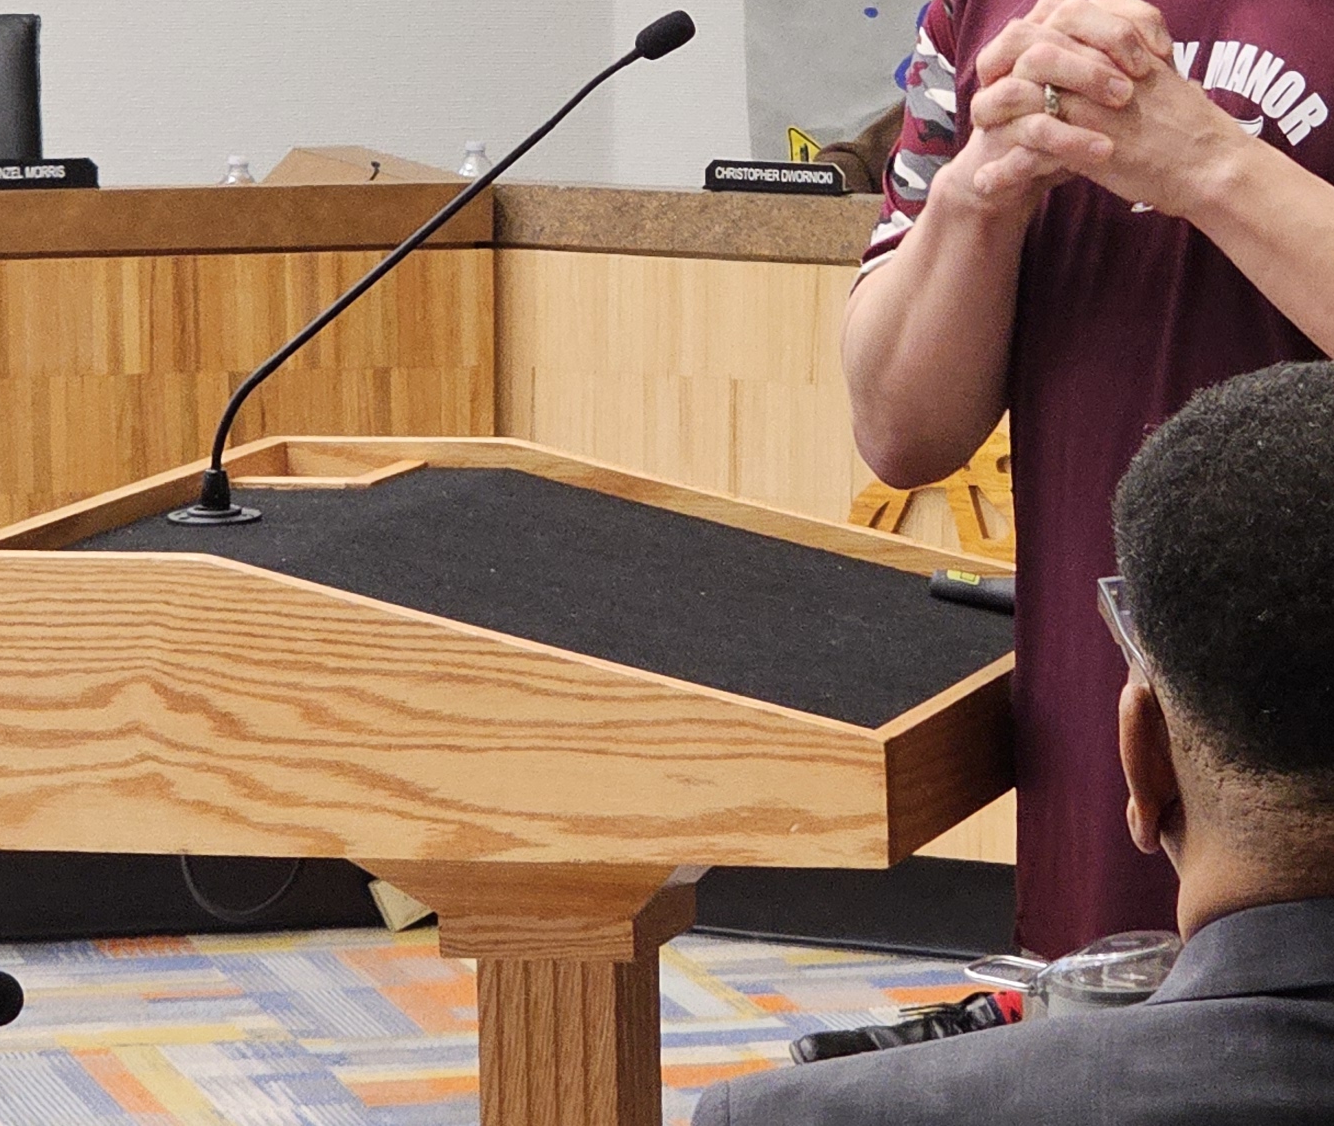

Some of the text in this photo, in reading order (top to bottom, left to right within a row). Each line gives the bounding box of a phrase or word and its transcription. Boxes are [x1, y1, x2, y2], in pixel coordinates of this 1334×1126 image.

[1202, 40, 1329, 147] MANOR
[24, 165, 66, 179] MORRIS
[715, 166, 834, 185] CHRISTOPHER DWORNICKI
